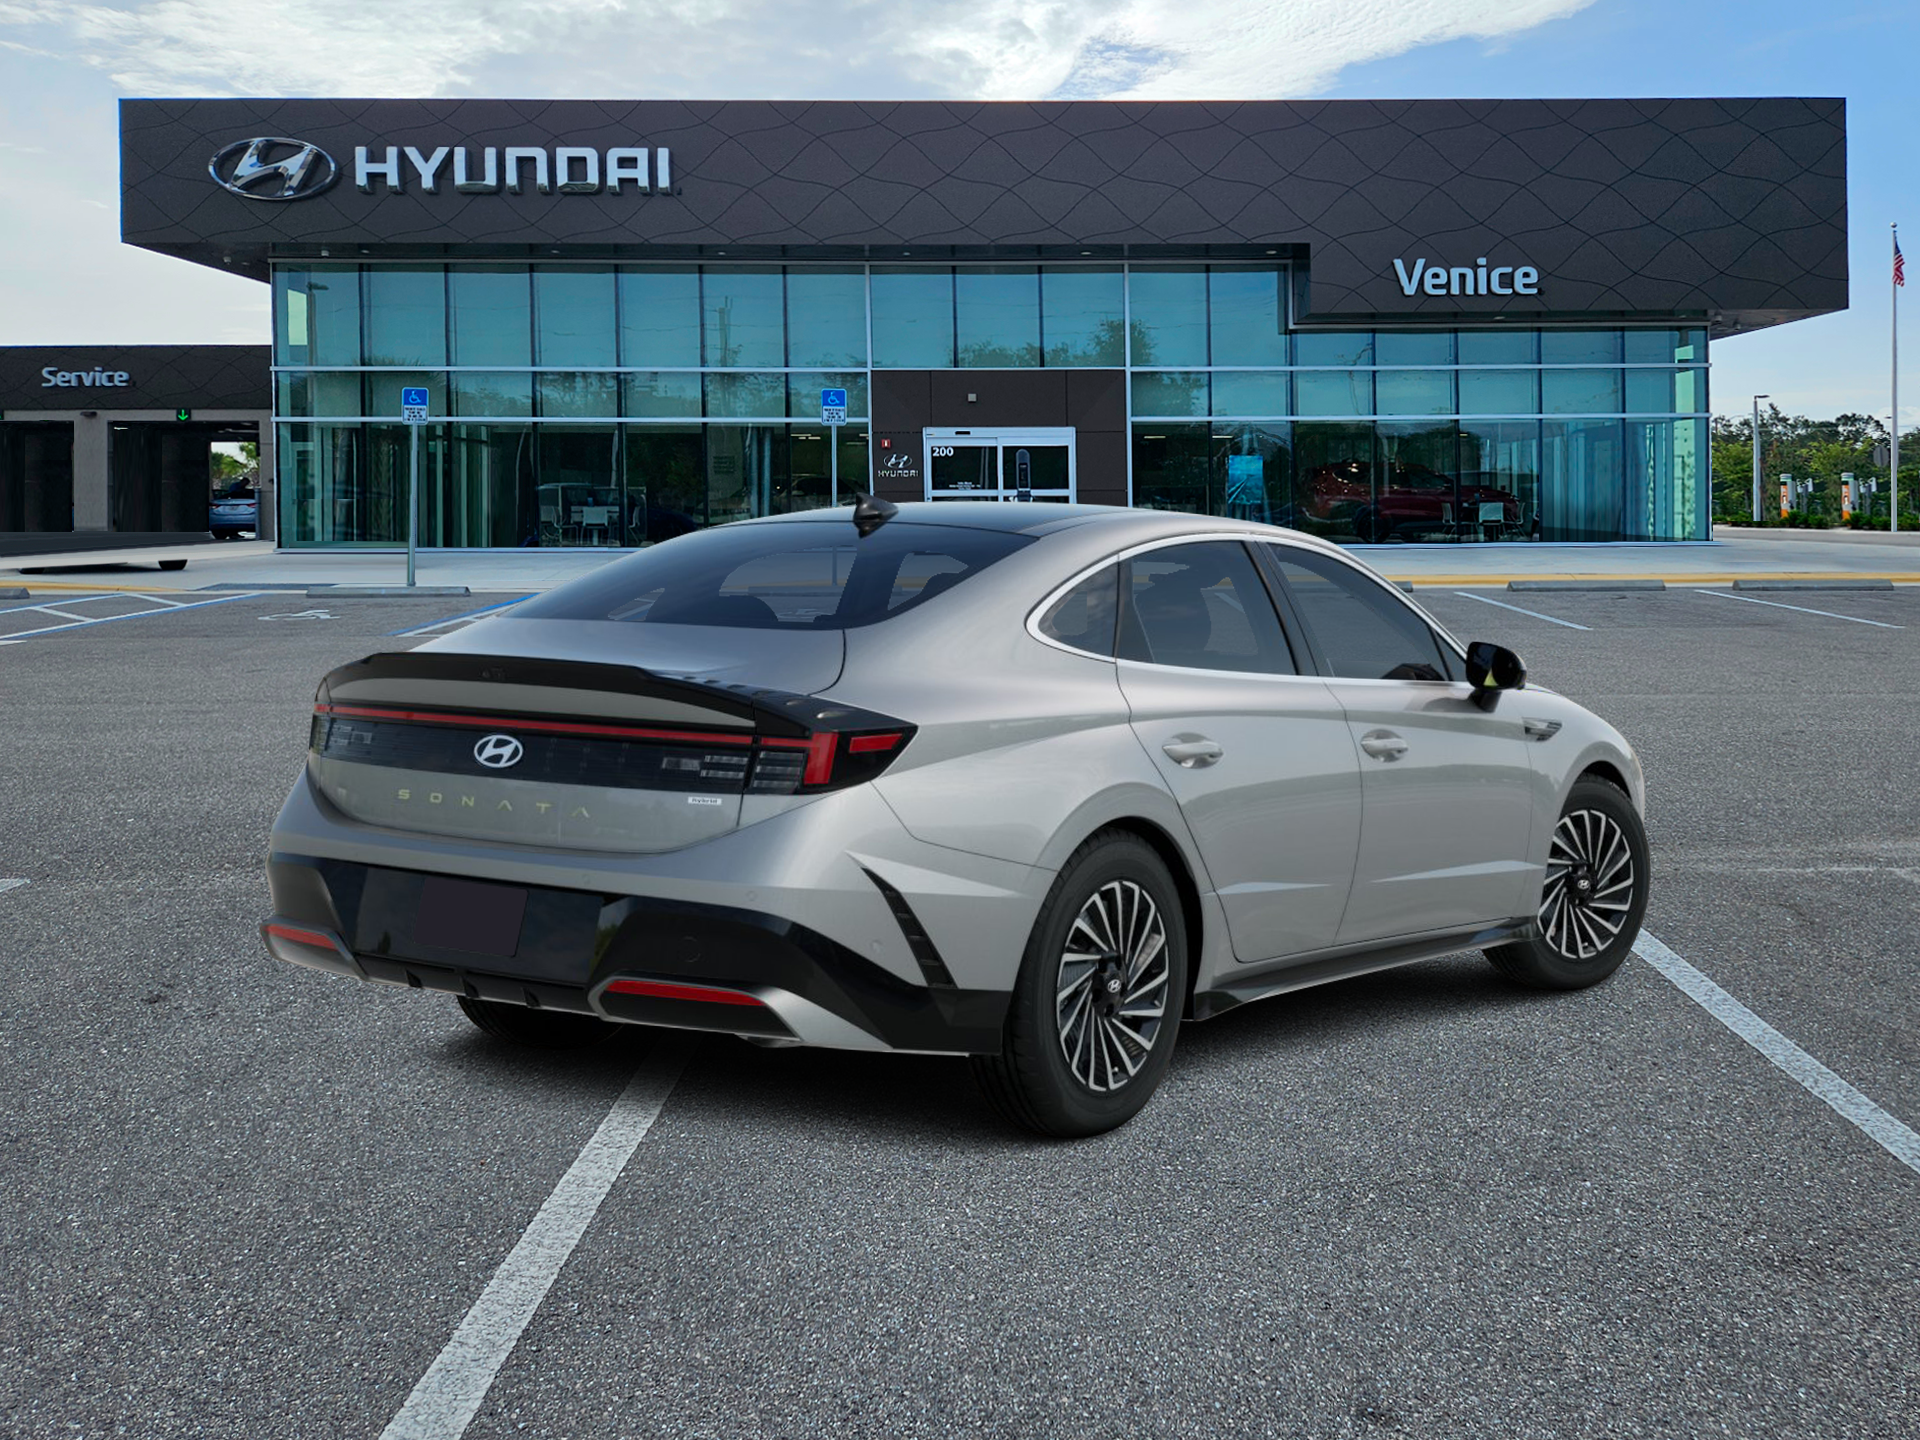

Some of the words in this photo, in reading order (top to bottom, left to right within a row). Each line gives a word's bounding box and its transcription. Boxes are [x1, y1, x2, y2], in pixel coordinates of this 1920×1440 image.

[354, 146, 669, 194] HYUNDAI
[1393, 257, 1538, 296] Venice
[41, 366, 130, 387] Service
[932, 446, 954, 457] 200
[877, 470, 918, 478] HYUNDAI
[398, 788, 590, 818] SONATA
